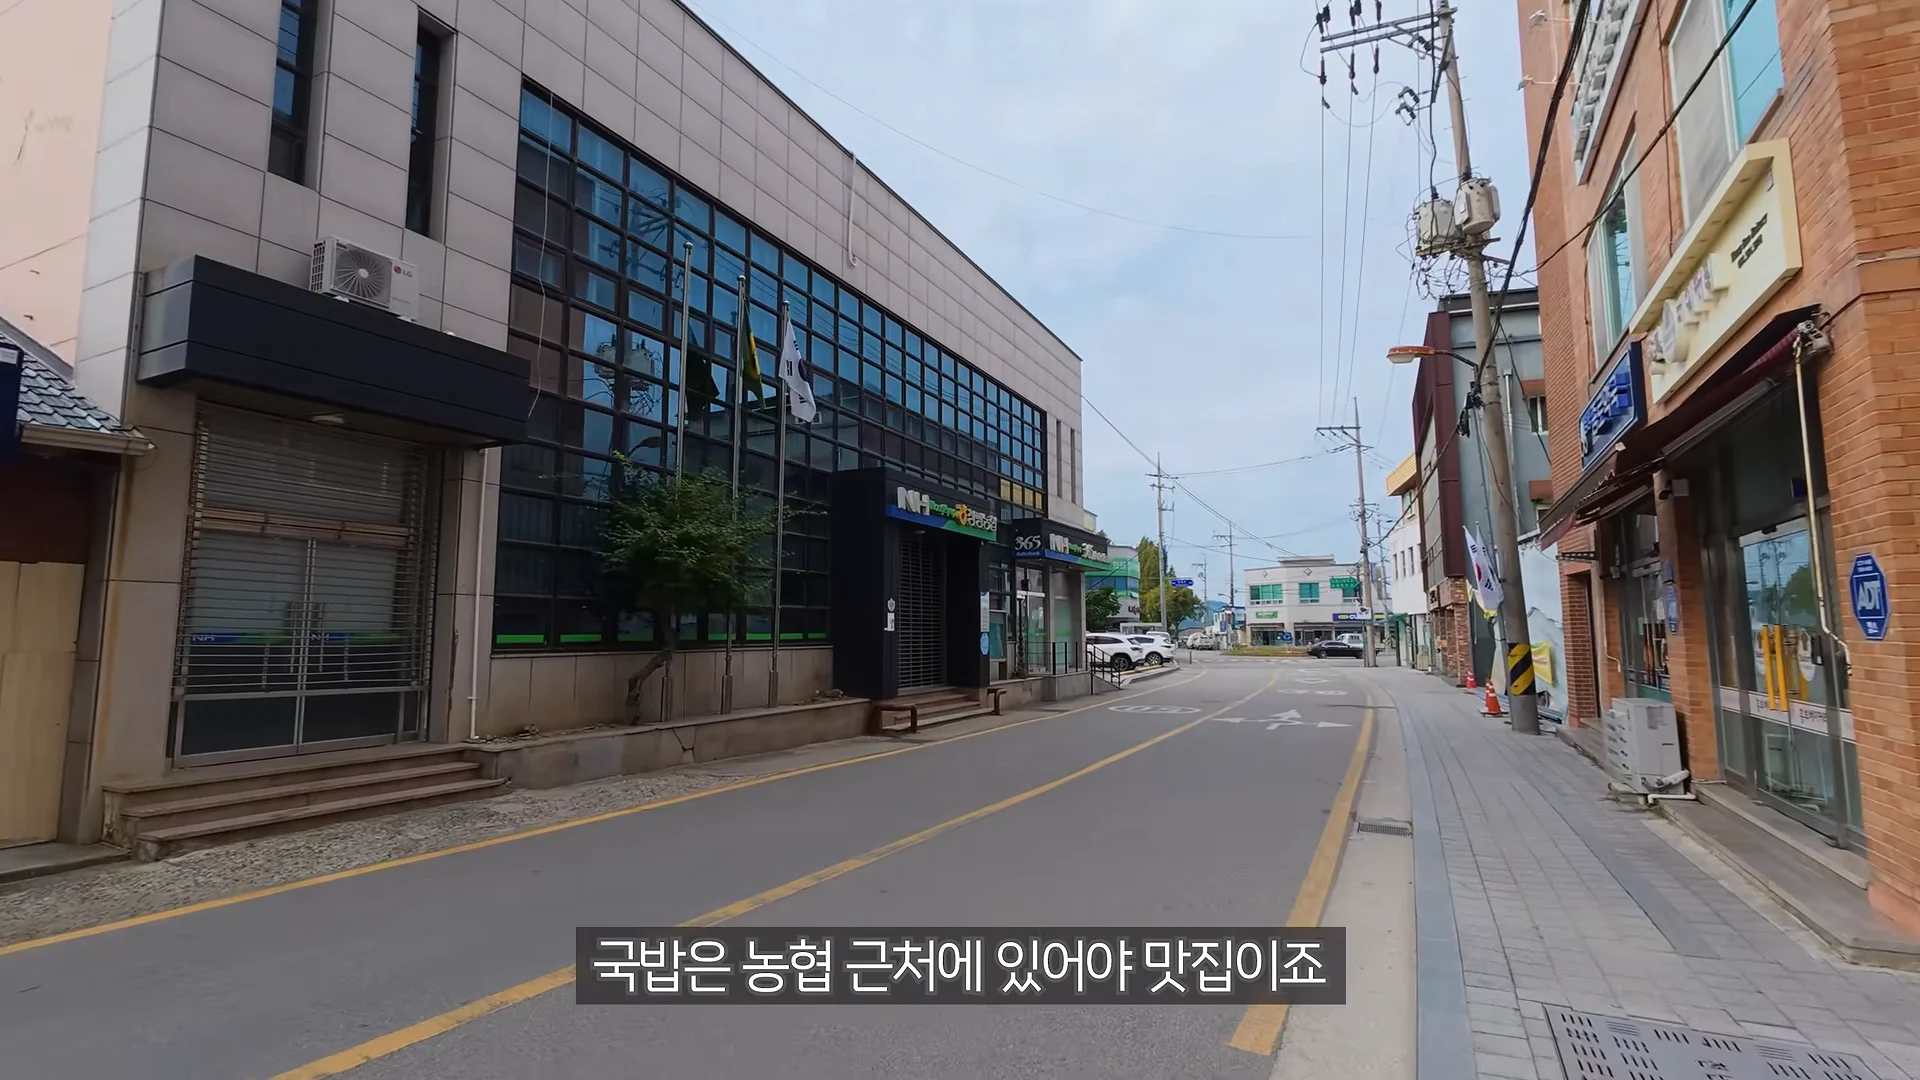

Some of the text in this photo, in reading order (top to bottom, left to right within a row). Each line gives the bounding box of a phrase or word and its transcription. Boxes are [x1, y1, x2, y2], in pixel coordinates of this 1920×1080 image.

[402, 270, 413, 278] LG
[897, 486, 930, 517] NH
[1014, 535, 1042, 551] 365
[1857, 580, 1881, 611] ADT
